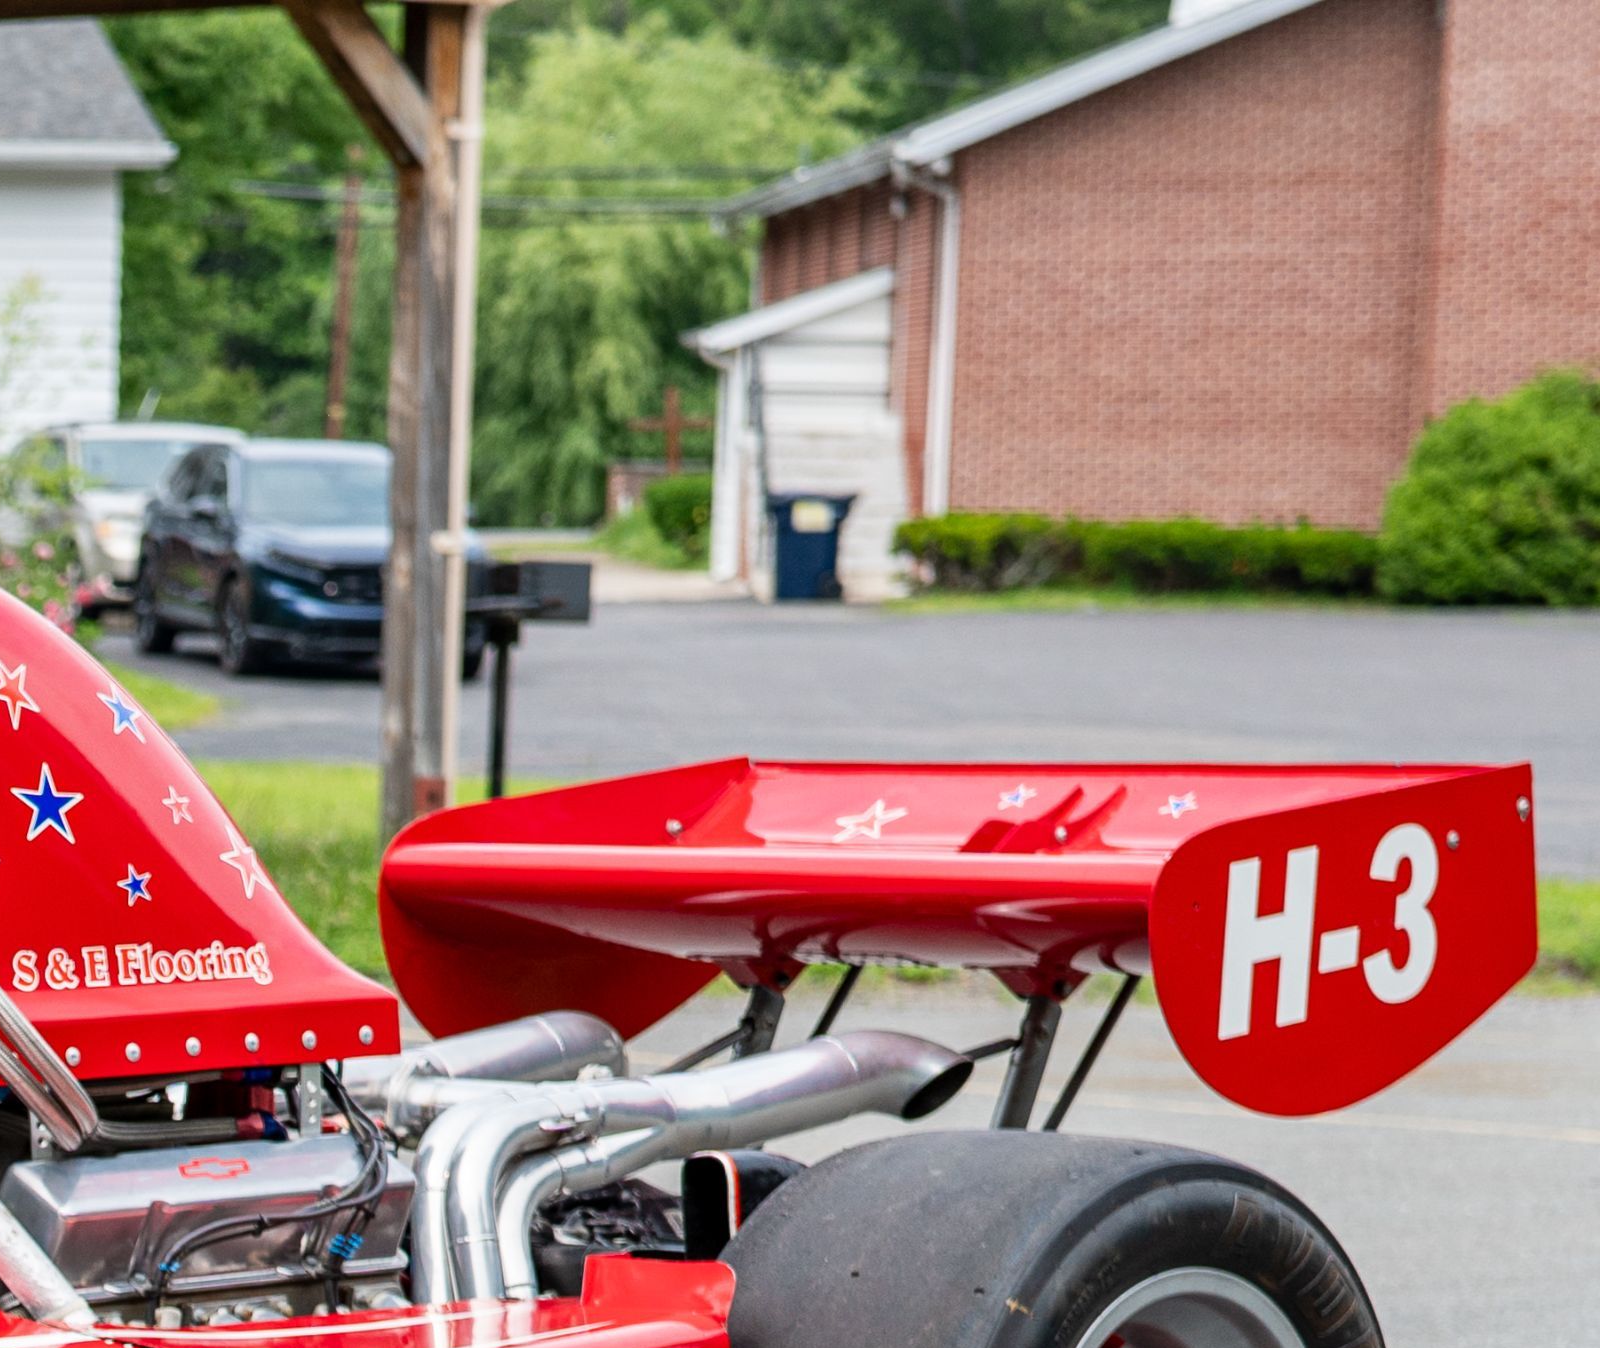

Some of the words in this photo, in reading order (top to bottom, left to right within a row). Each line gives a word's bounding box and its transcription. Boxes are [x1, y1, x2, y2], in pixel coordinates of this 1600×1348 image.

[12, 950, 39, 991] S
[45, 948, 79, 990] &
[81, 945, 111, 987] E
[115, 940, 273, 986] Flooring
[1218, 822, 1439, 1041] H-3
